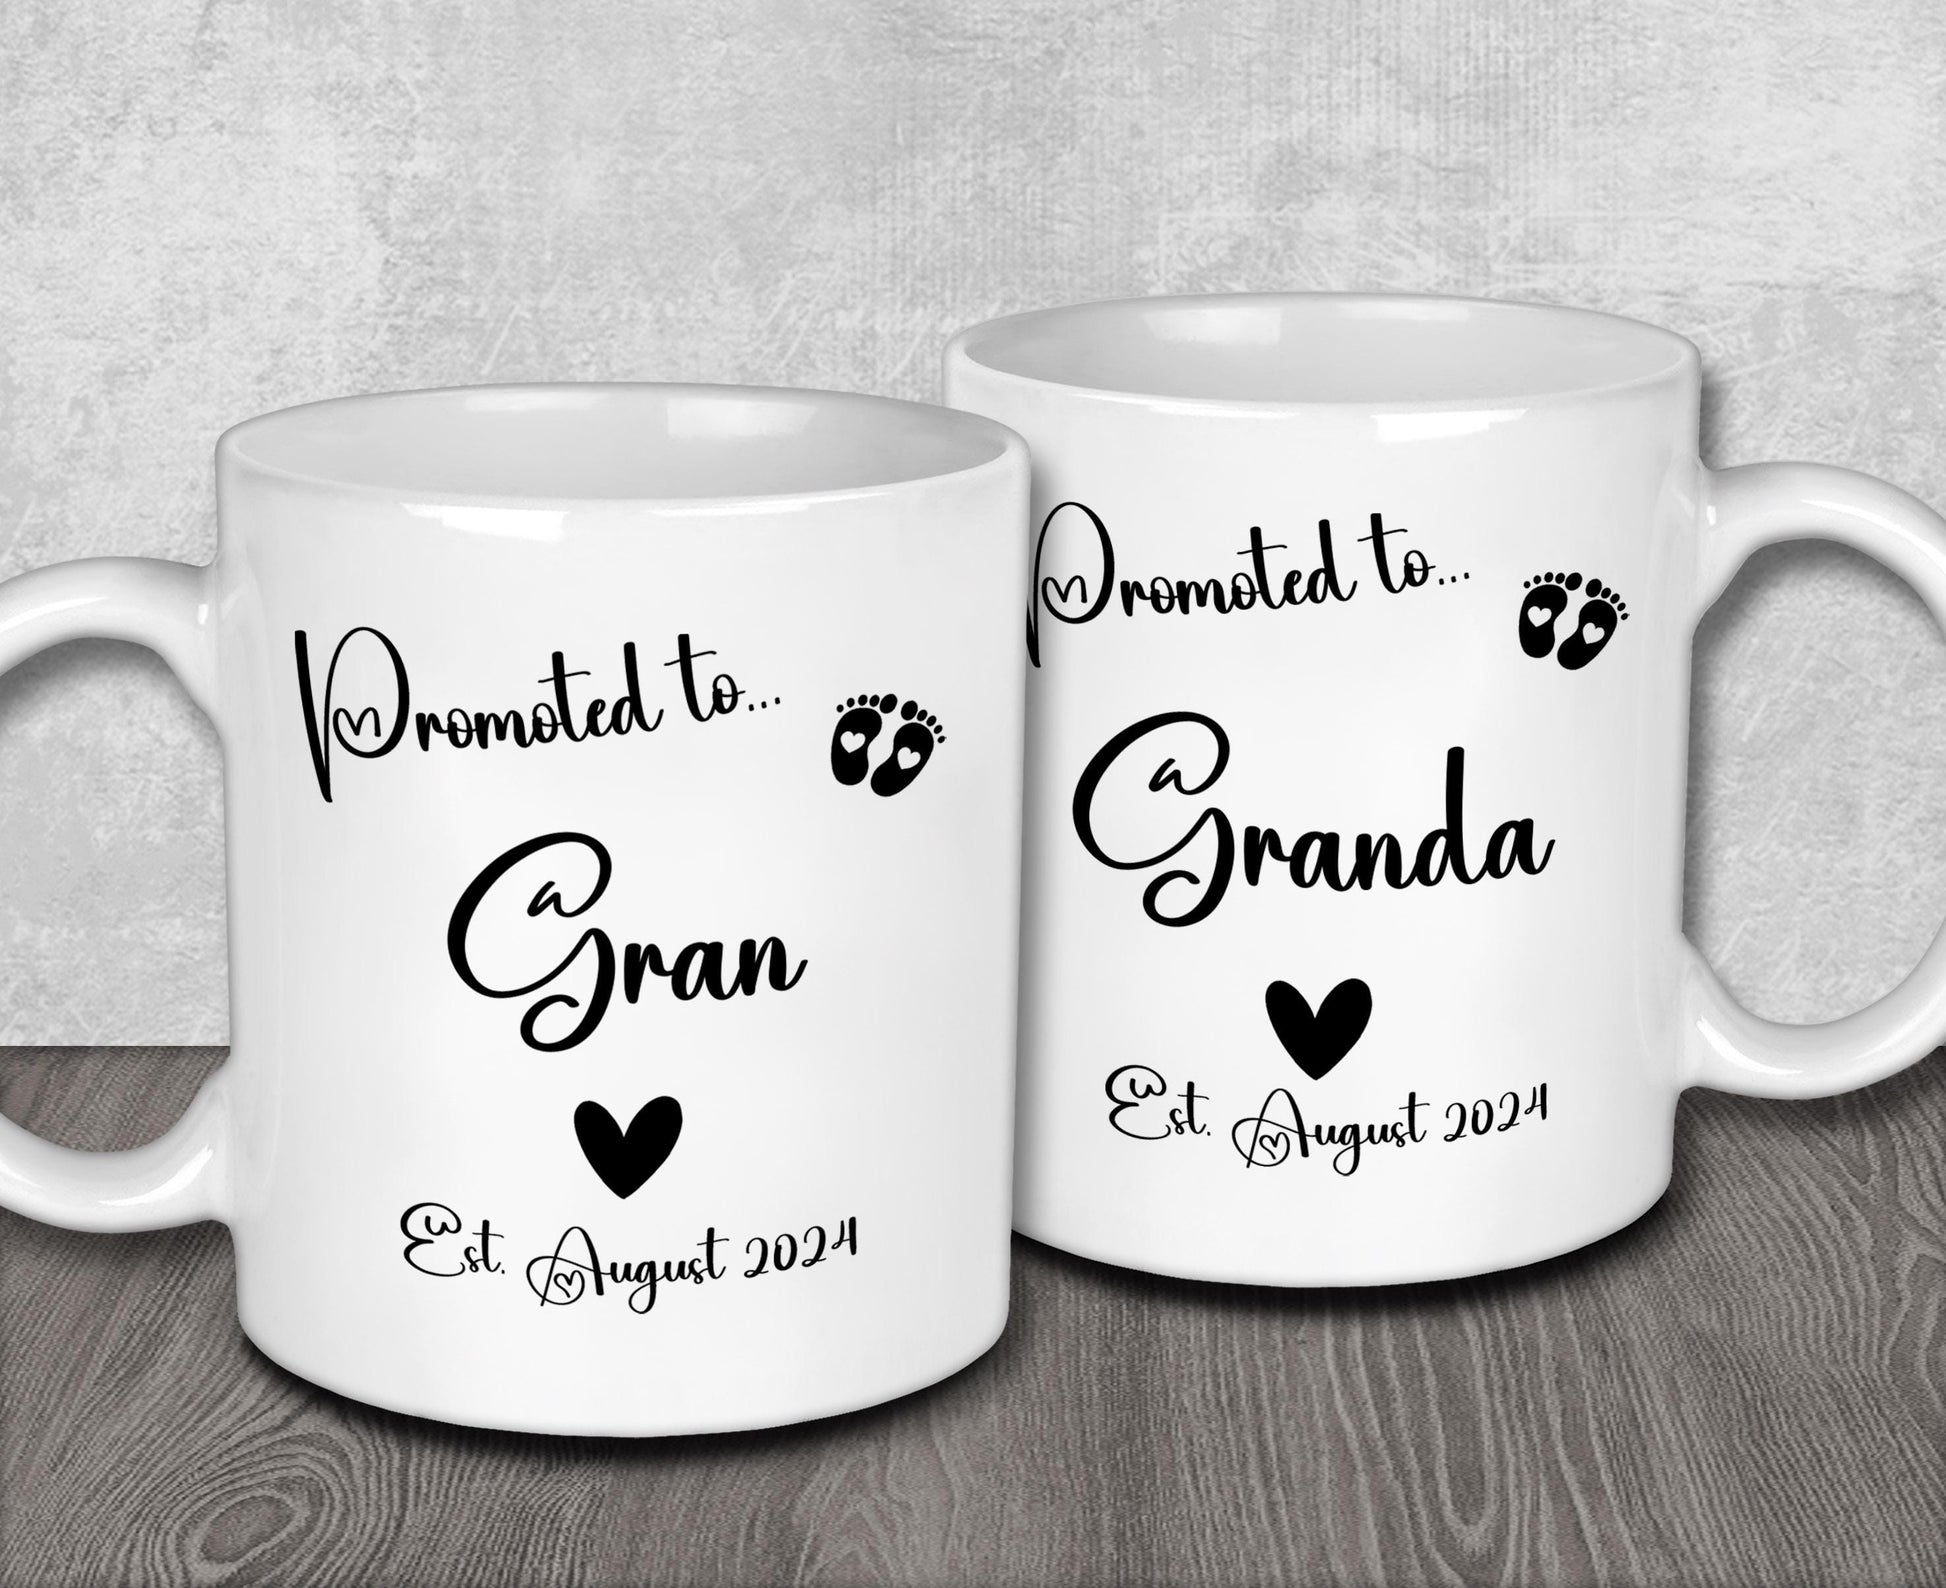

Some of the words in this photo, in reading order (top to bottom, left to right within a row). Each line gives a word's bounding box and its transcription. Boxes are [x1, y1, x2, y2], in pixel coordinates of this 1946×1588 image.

[1026, 501, 1358, 669] Promoted
[1357, 512, 1471, 594] to...
[294, 626, 666, 803] Promoted
[664, 633, 782, 723] to...
[1072, 711, 1556, 928] Granda
[447, 831, 809, 1053] Gran
[1104, 1064, 1211, 1141] Est.
[1231, 1088, 1430, 1177] August
[1443, 1082, 1549, 1143] 2024
[400, 1202, 506, 1278] Est.
[525, 1226, 730, 1315] August
[743, 1216, 859, 1279] 2024
